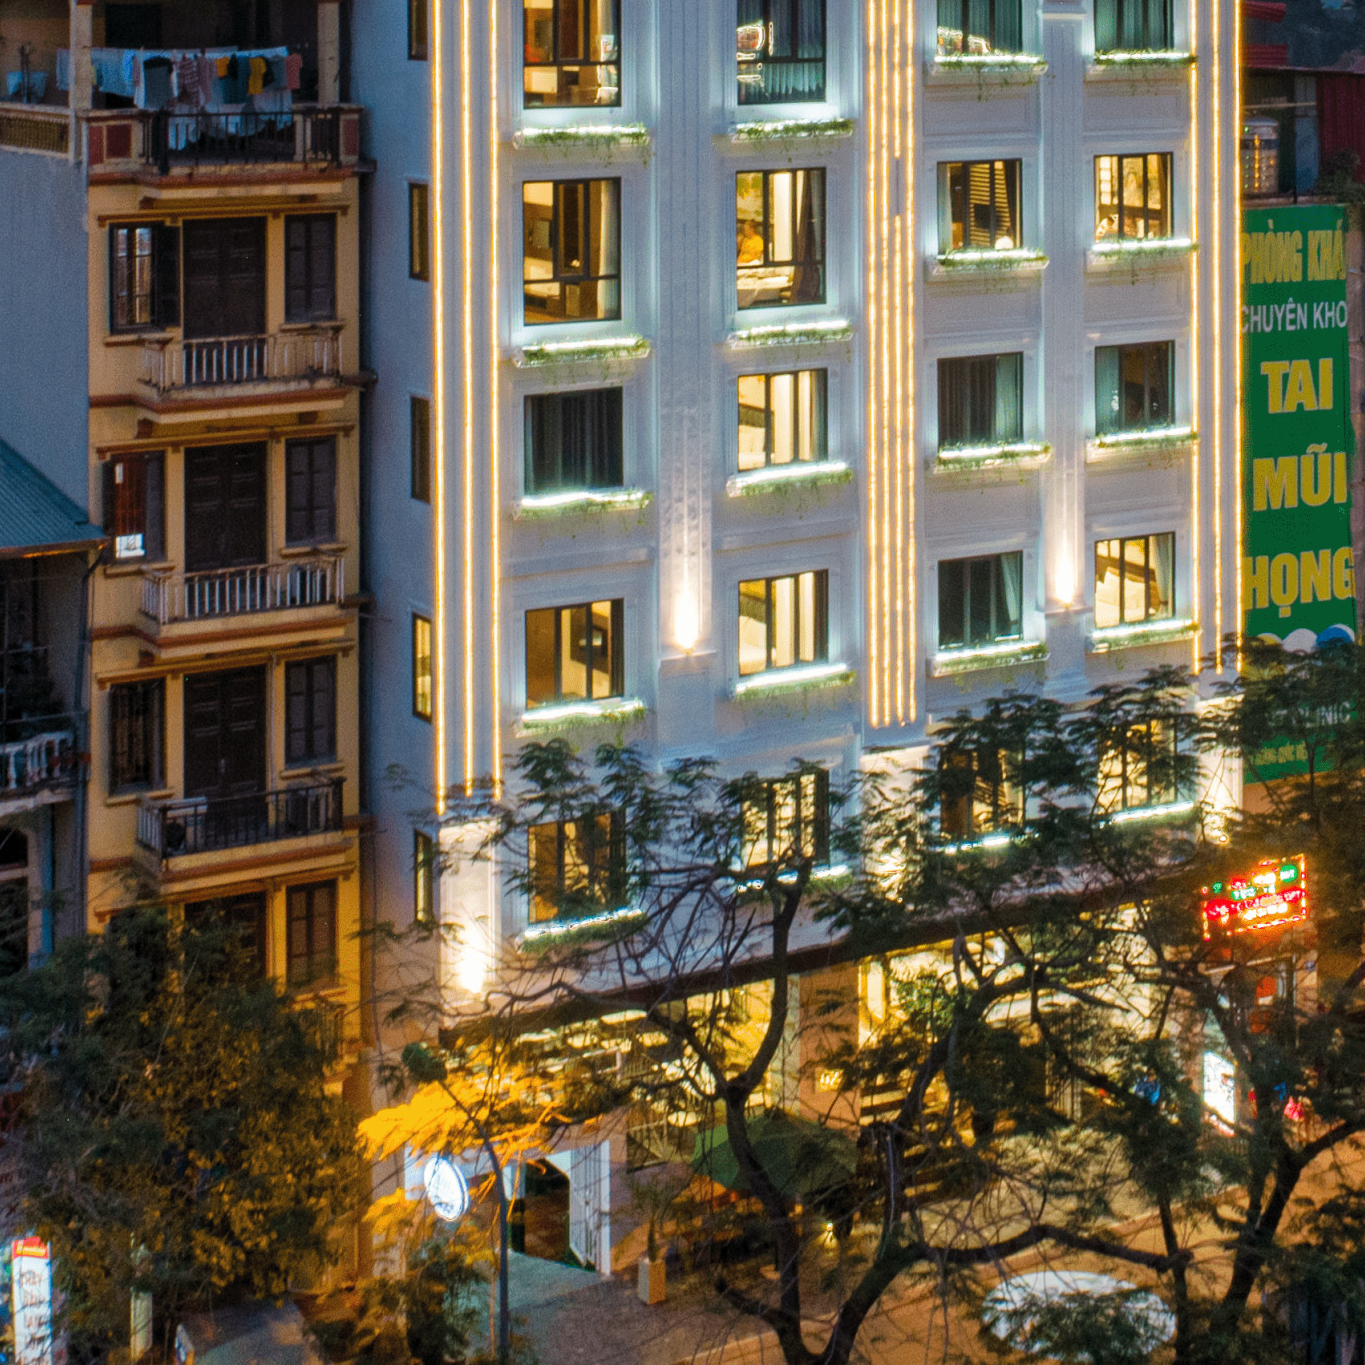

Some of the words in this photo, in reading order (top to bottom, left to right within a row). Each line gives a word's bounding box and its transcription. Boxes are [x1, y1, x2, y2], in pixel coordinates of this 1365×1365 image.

[1240, 219, 1303, 284] PHÒNG
[1308, 218, 1347, 282] KHÁ
[1241, 297, 1308, 333] CHUYÊN
[1313, 299, 1348, 330] KHO
[1260, 357, 1334, 414] TAI
[1253, 442, 1349, 512] MŨI
[1242, 546, 1356, 618] HỌNG
